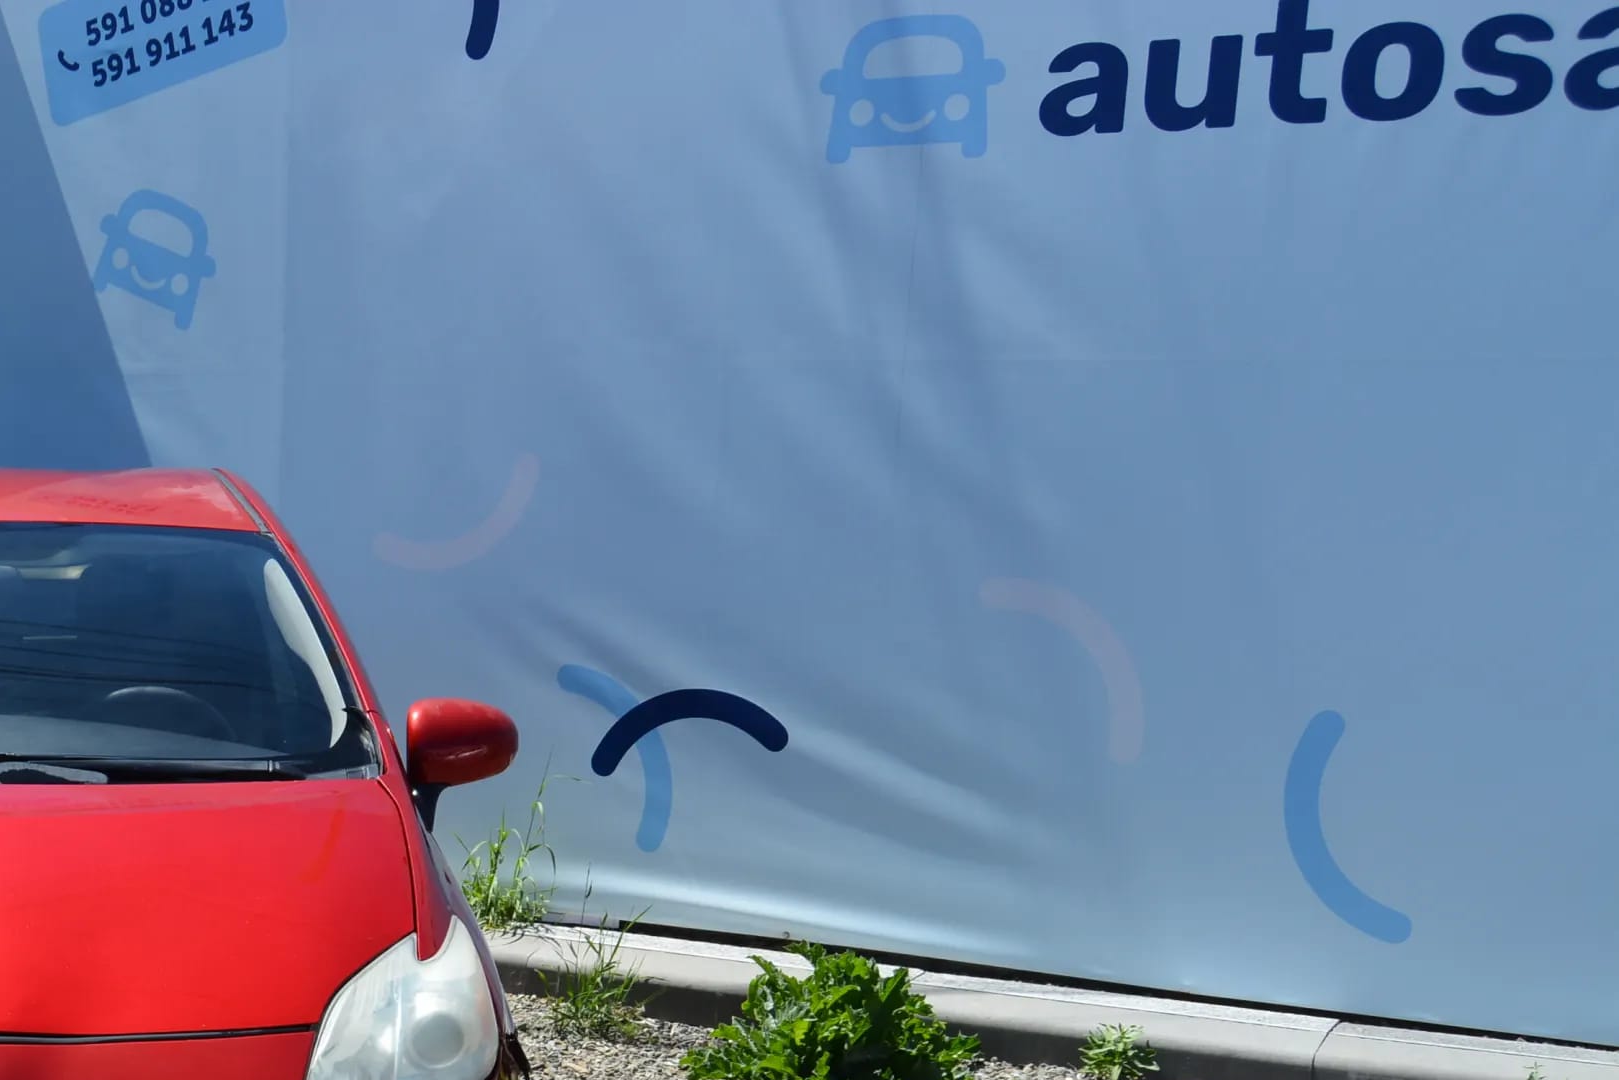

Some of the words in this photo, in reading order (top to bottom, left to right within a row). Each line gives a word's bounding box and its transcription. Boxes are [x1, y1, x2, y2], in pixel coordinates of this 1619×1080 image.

[85, 5, 135, 47] 591
[91, 46, 141, 88] 591
[145, 25, 196, 68] 911
[201, 1, 254, 47] 143
